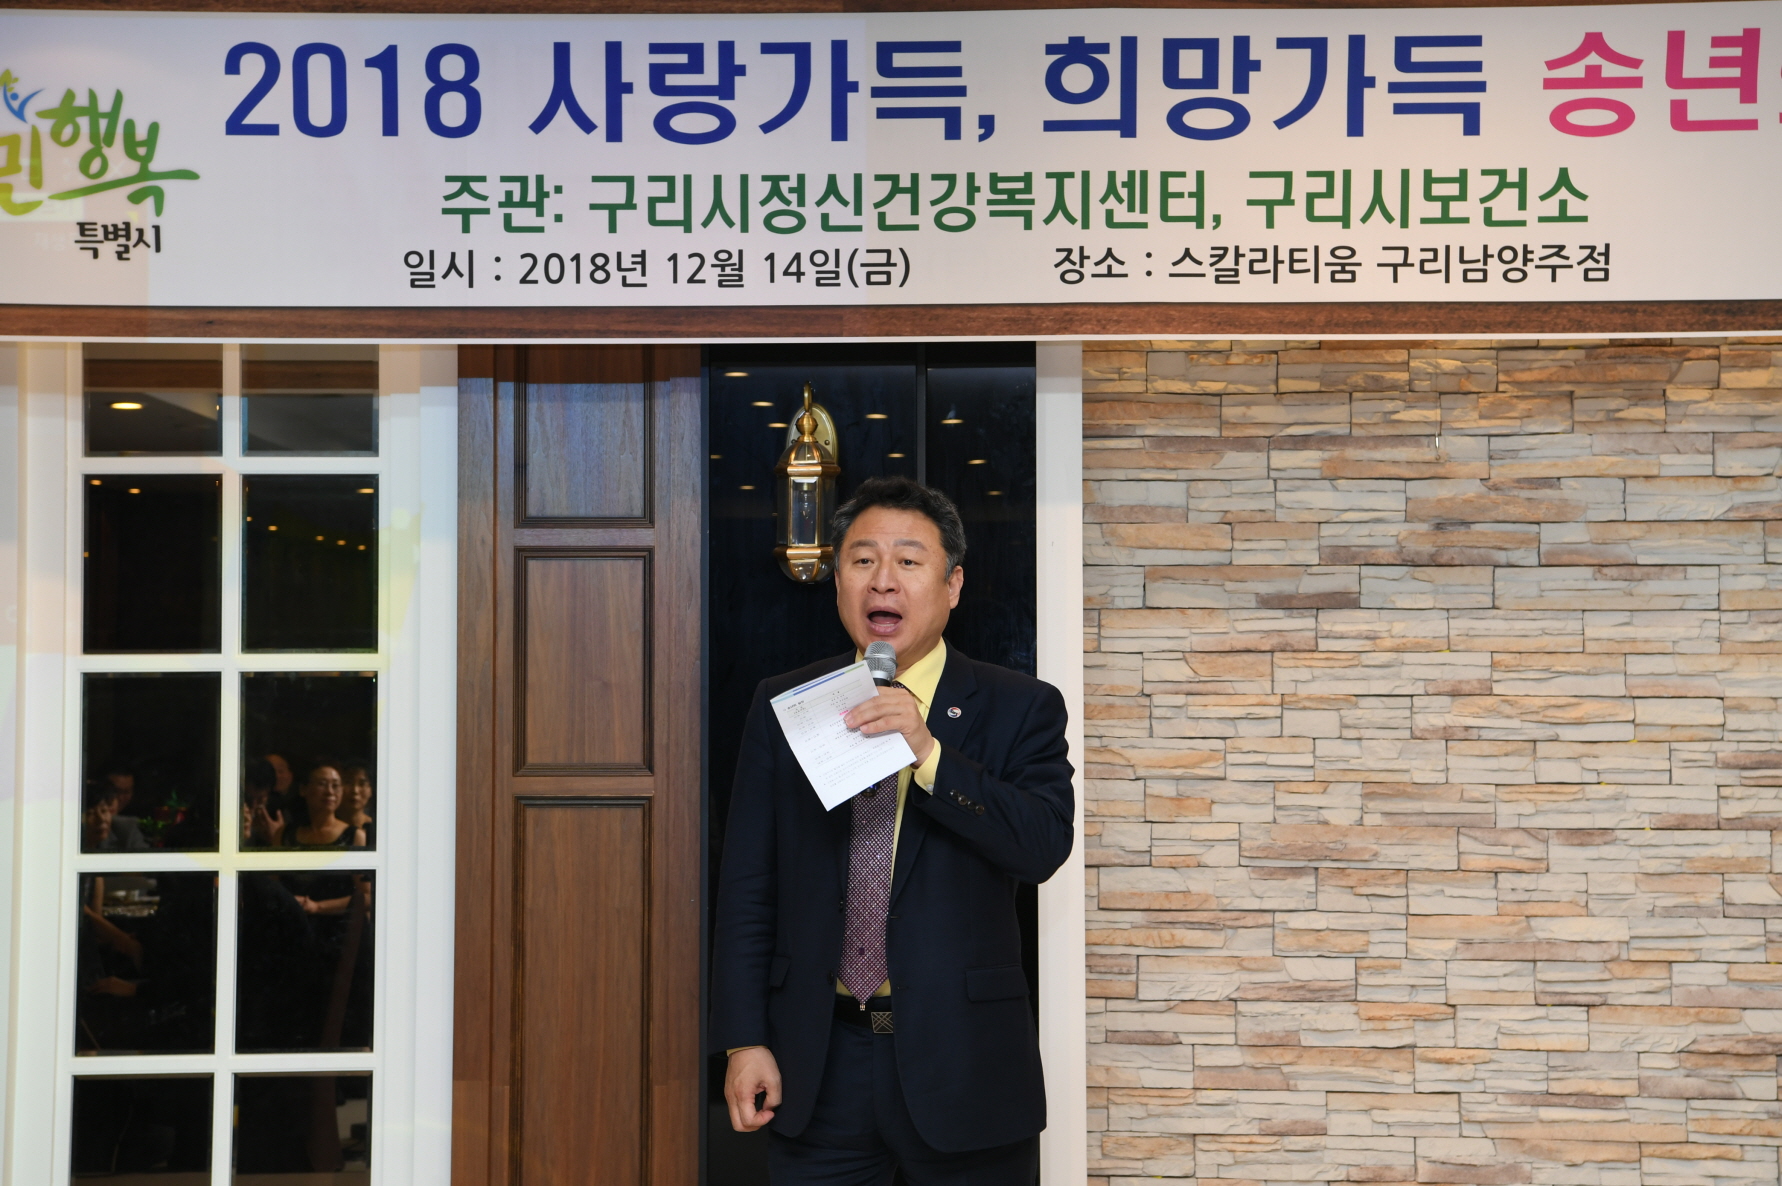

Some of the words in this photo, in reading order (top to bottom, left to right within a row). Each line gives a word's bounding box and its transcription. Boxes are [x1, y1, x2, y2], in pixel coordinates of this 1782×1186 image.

[224, 41, 482, 139] 2018
[528, 40, 996, 146] 사랑가득,
[1042, 35, 1487, 141] 희망가득
[1542, 27, 1782, 138] 송년
[441, 174, 563, 234] 주관:
[588, 169, 1222, 235] 구리시정신건강복지센터,
[1246, 166, 1589, 230] 구리시보건소
[74, 221, 162, 261] 특별시
[403, 249, 474, 289] 일시
[494, 256, 502, 282] :
[519, 249, 648, 288] 2018년
[666, 248, 745, 289] 12월
[764, 247, 911, 289] 14일(금)
[1053, 245, 1129, 285] 장소
[1145, 251, 1153, 277] :
[1168, 244, 1363, 285] 스칼라티움
[1376, 242, 1611, 284] 구리남양주점
